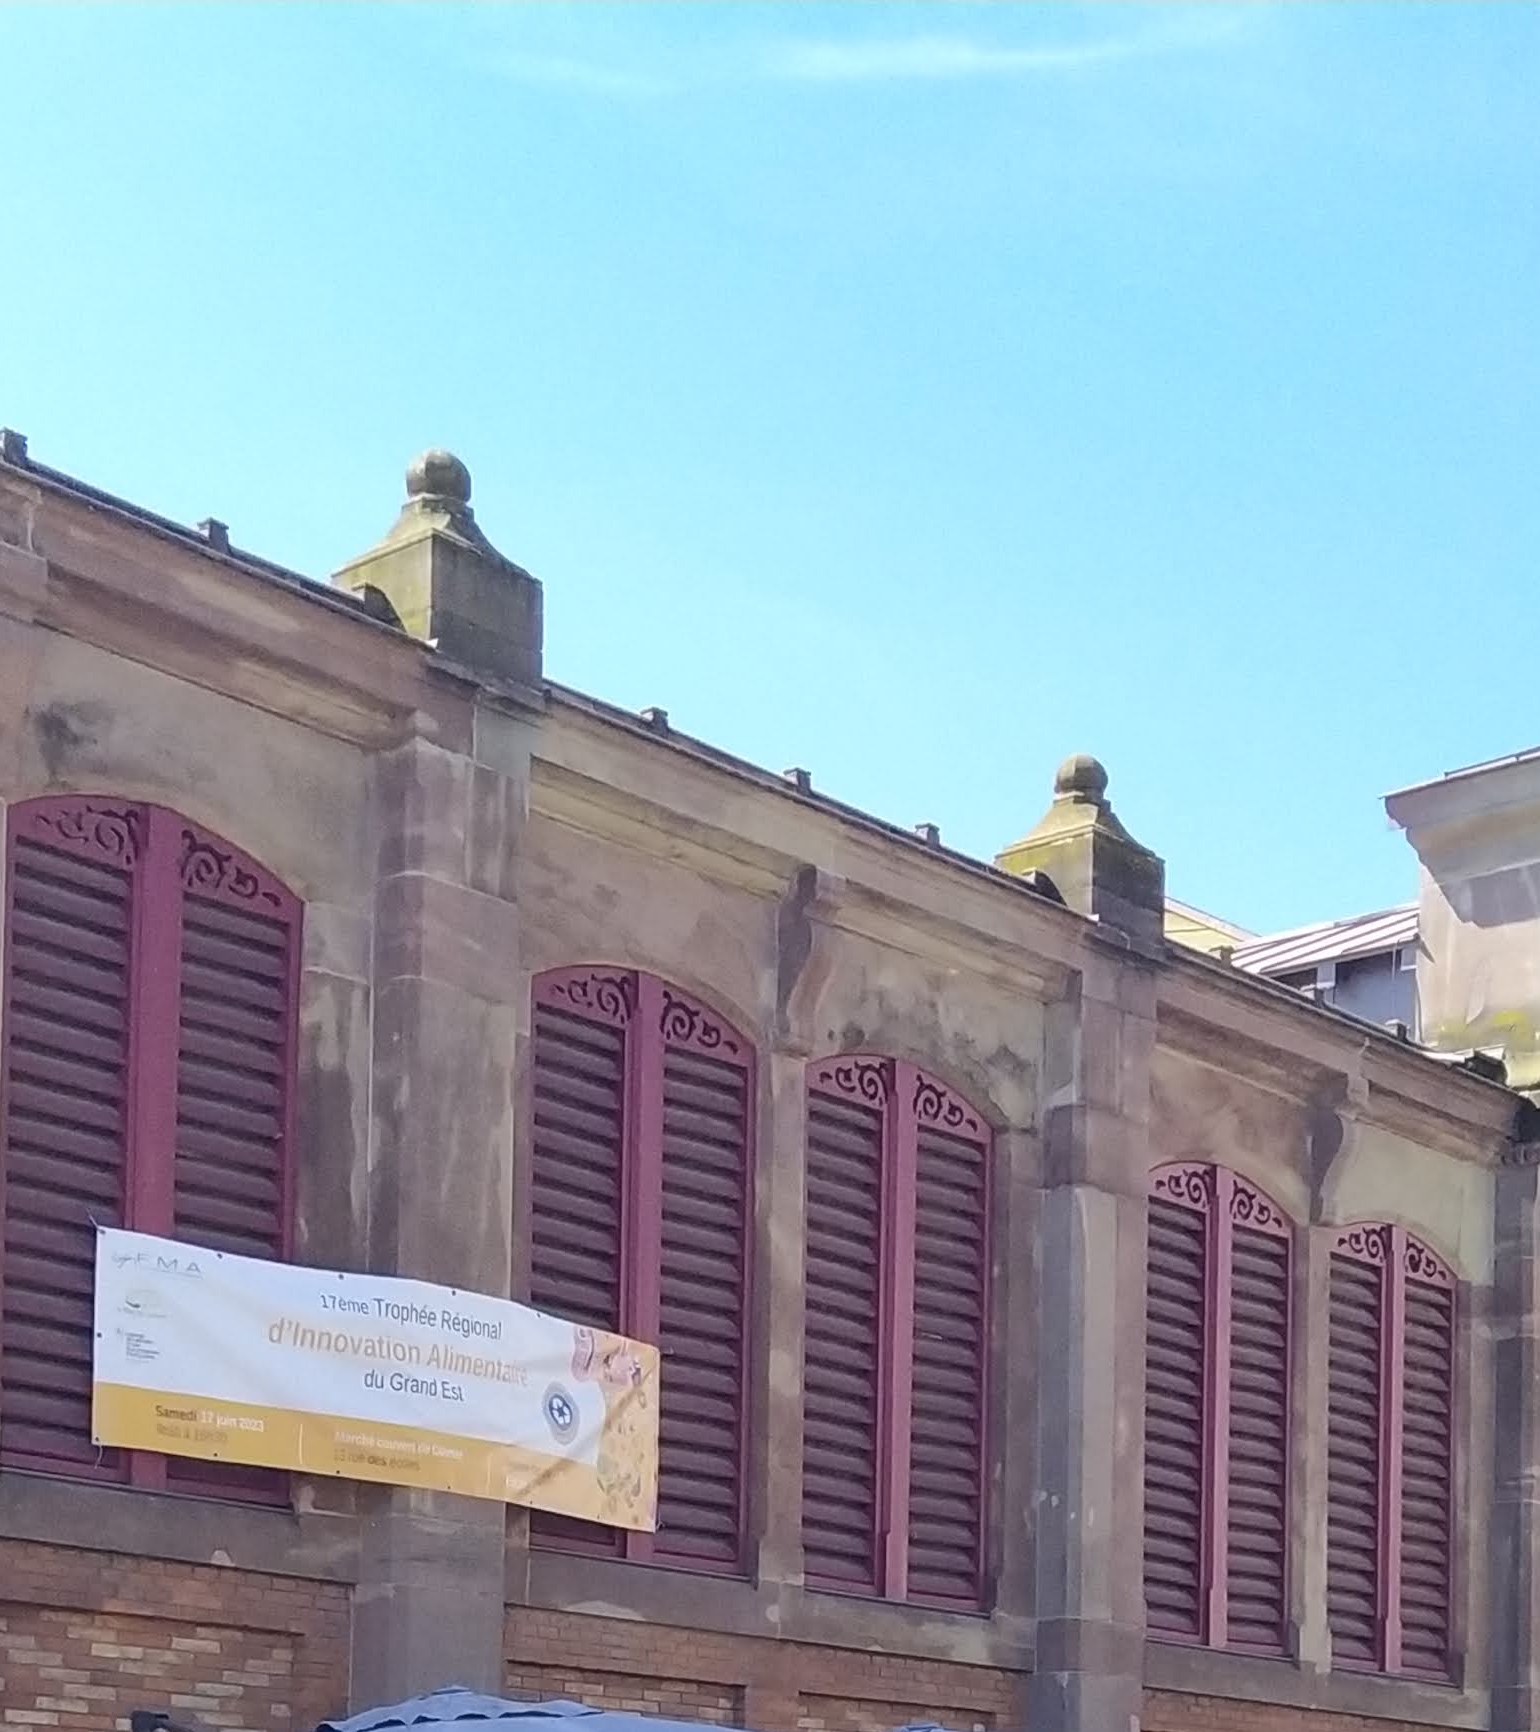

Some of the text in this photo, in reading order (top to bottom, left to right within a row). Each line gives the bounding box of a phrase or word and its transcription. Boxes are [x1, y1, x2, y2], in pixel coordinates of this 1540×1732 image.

[373, 1298, 437, 1327] Trophée
[441, 1310, 502, 1341] Régional
[268, 1317, 529, 1387] d'Innovation Alimentaire
[364, 1369, 466, 1402] du Grand Est
[155, 1404, 197, 1421] Samedi
[216, 1412, 238, 1428] juin
[367, 1454, 387, 1467] des
